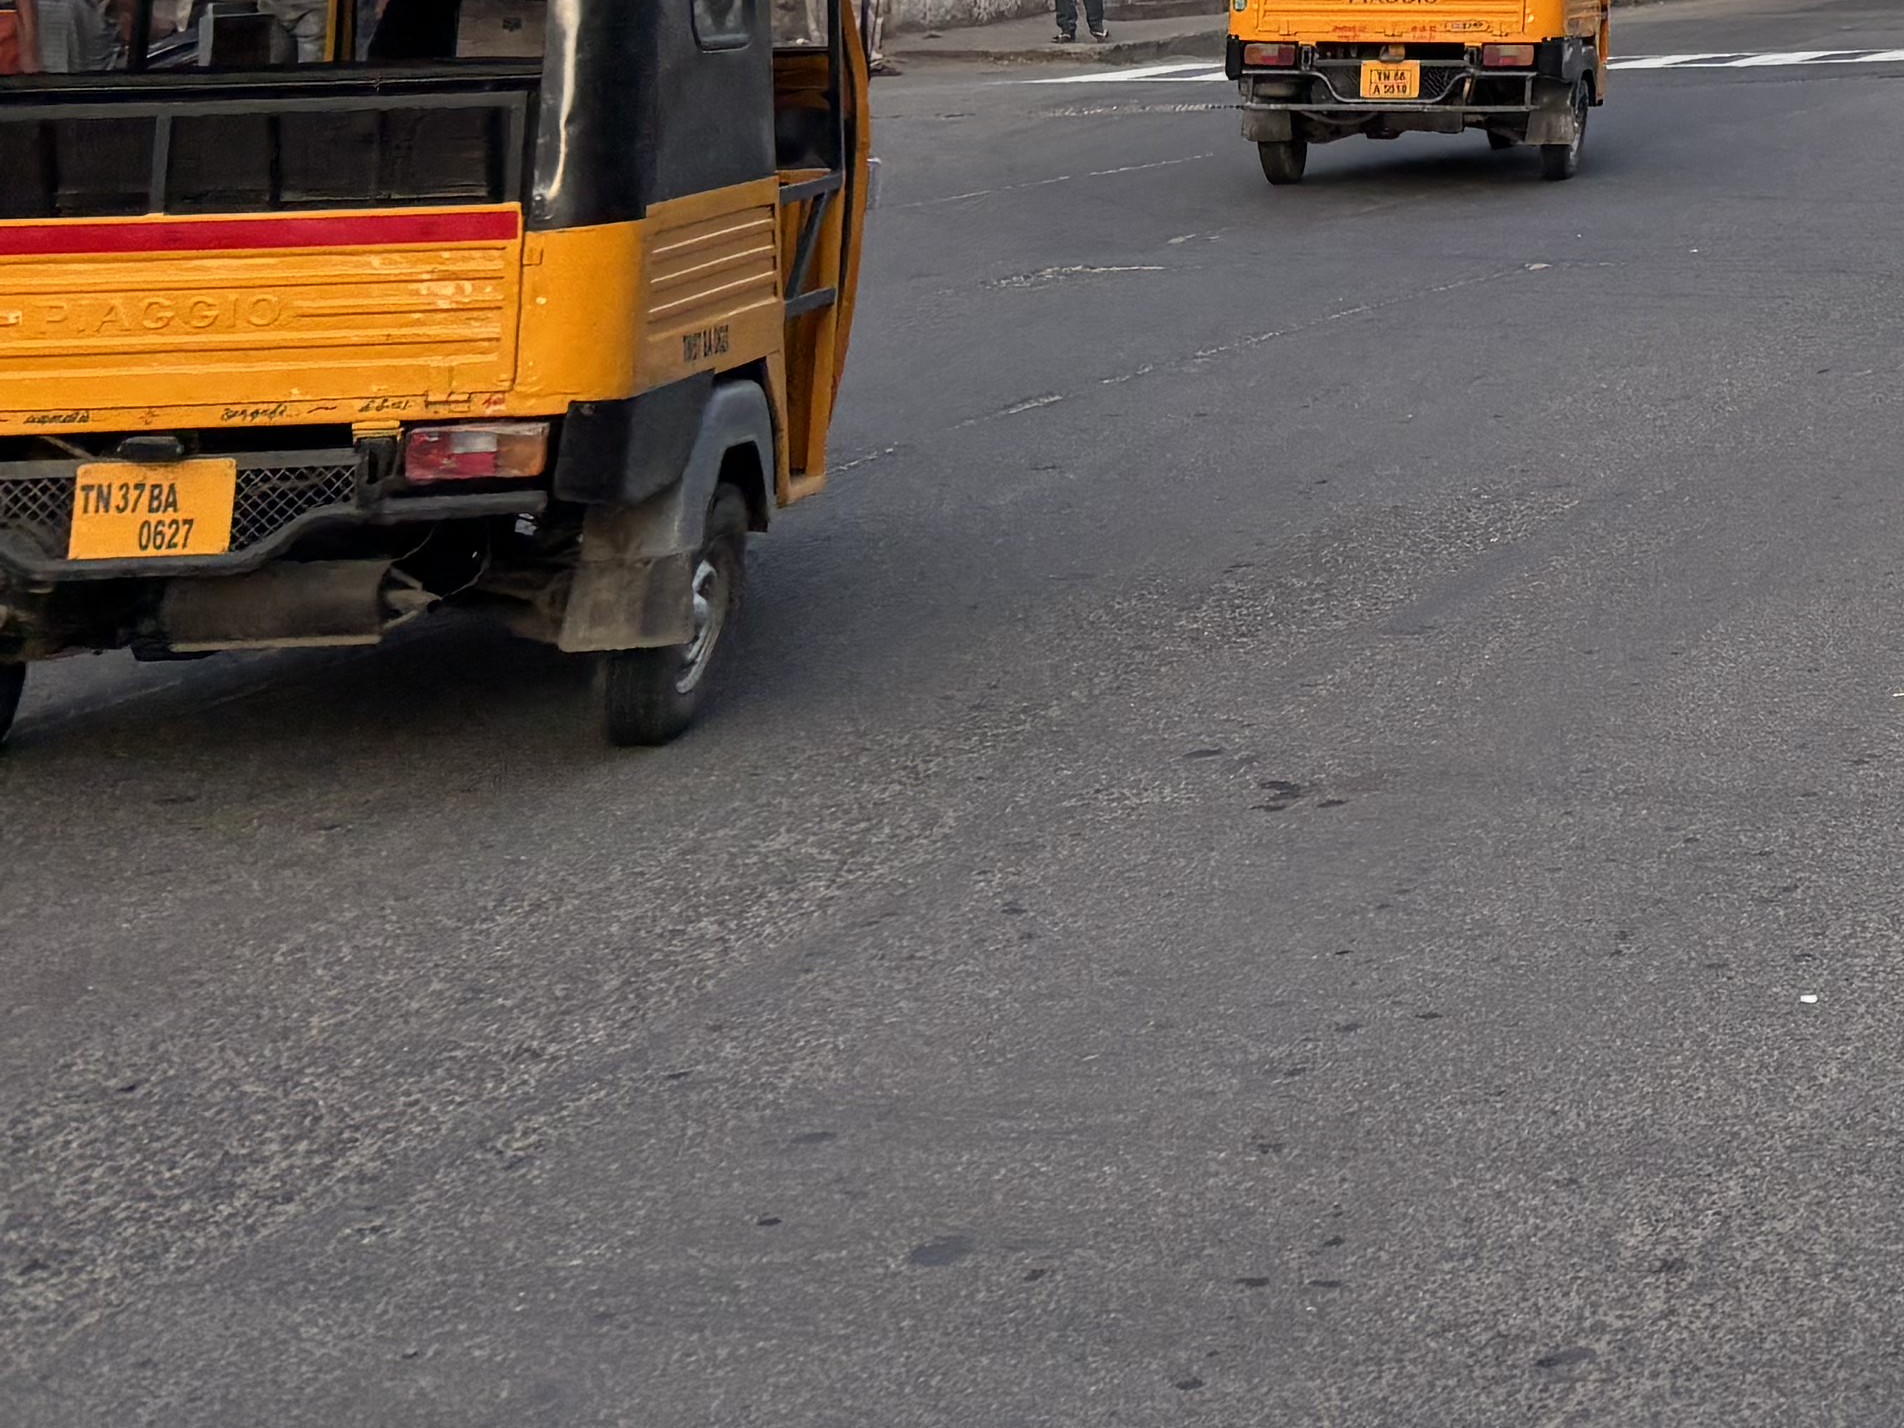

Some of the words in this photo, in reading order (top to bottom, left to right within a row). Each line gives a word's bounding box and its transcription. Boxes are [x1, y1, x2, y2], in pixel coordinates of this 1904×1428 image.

[82, 484, 110, 514] TN
[115, 483, 145, 513] 37
[149, 484, 178, 513] BA
[139, 519, 194, 550] 0627
